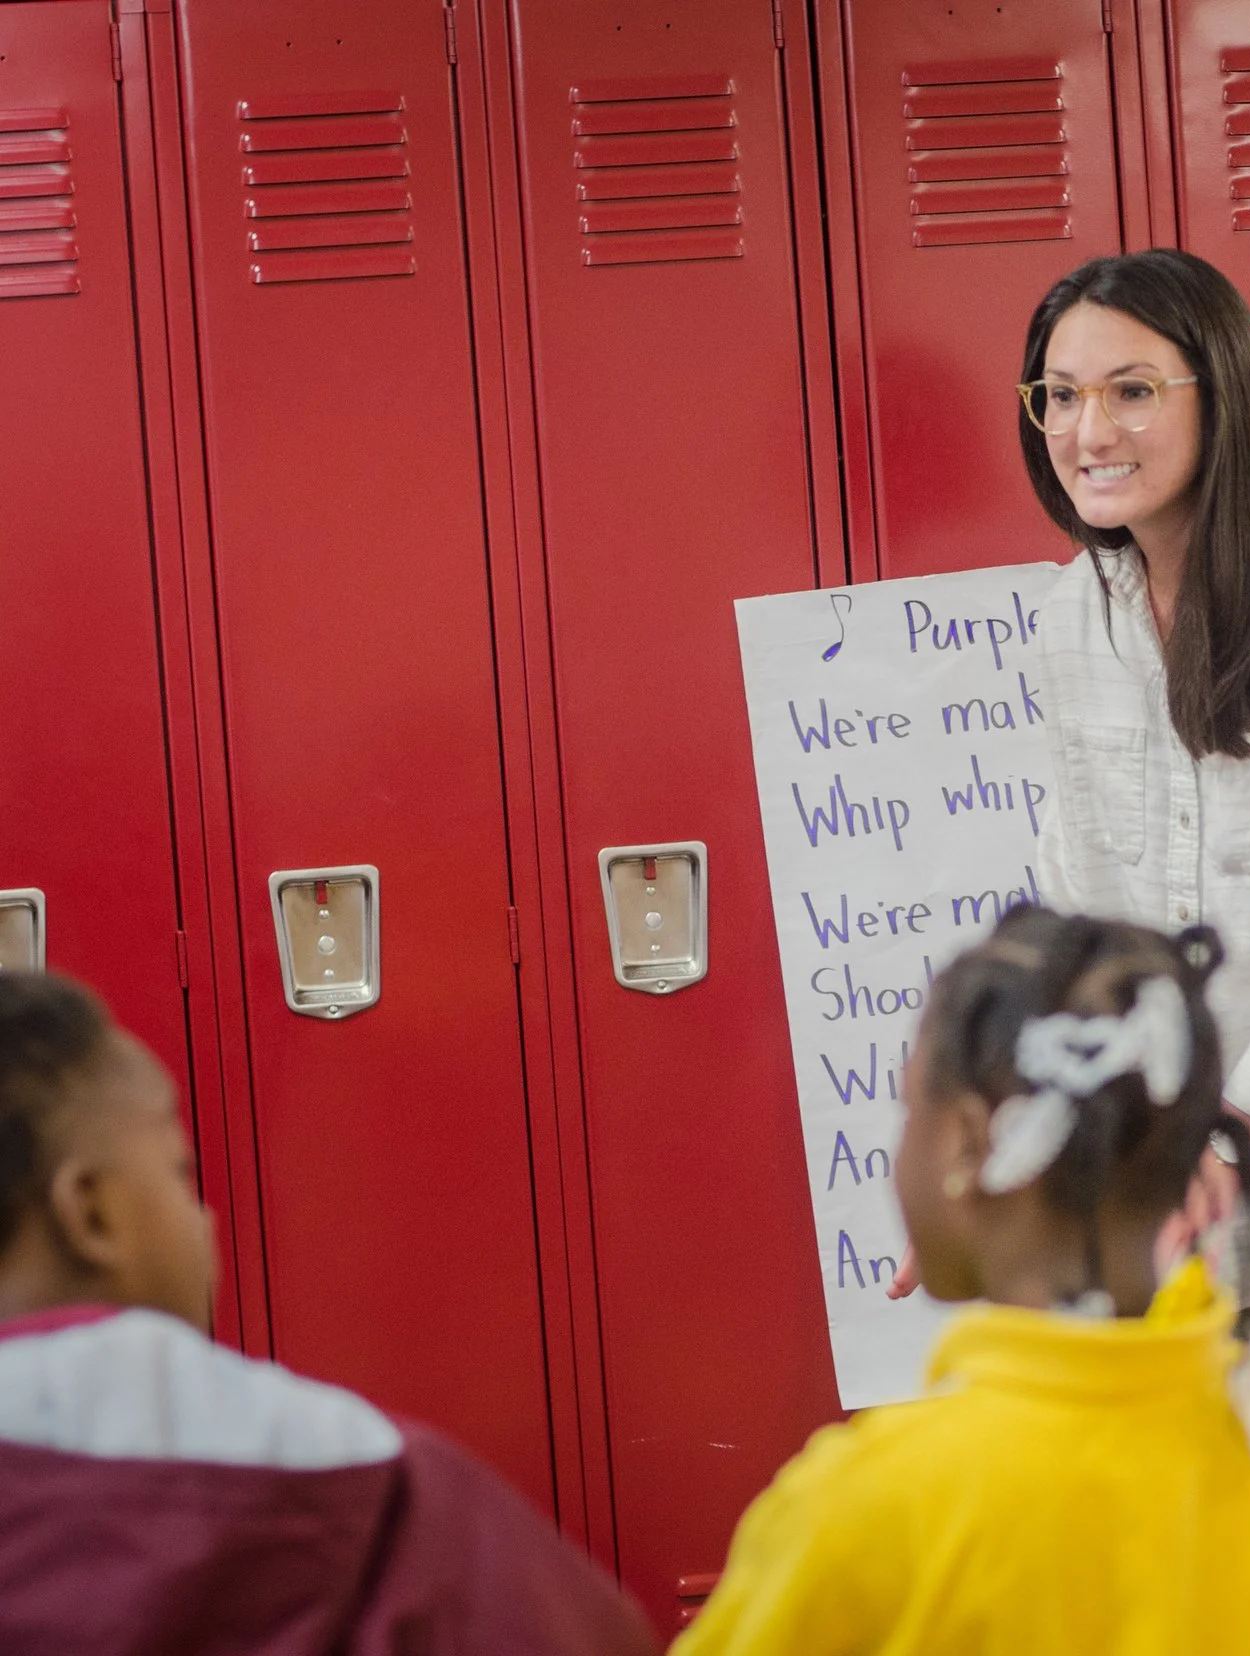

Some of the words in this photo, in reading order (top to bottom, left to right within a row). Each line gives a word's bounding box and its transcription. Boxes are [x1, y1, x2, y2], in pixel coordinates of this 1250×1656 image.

[787, 697, 912, 753] We're
[941, 671, 1045, 735] mak
[791, 773, 911, 852] Whip
[941, 754, 1047, 837] whip
[799, 890, 933, 949] We're
